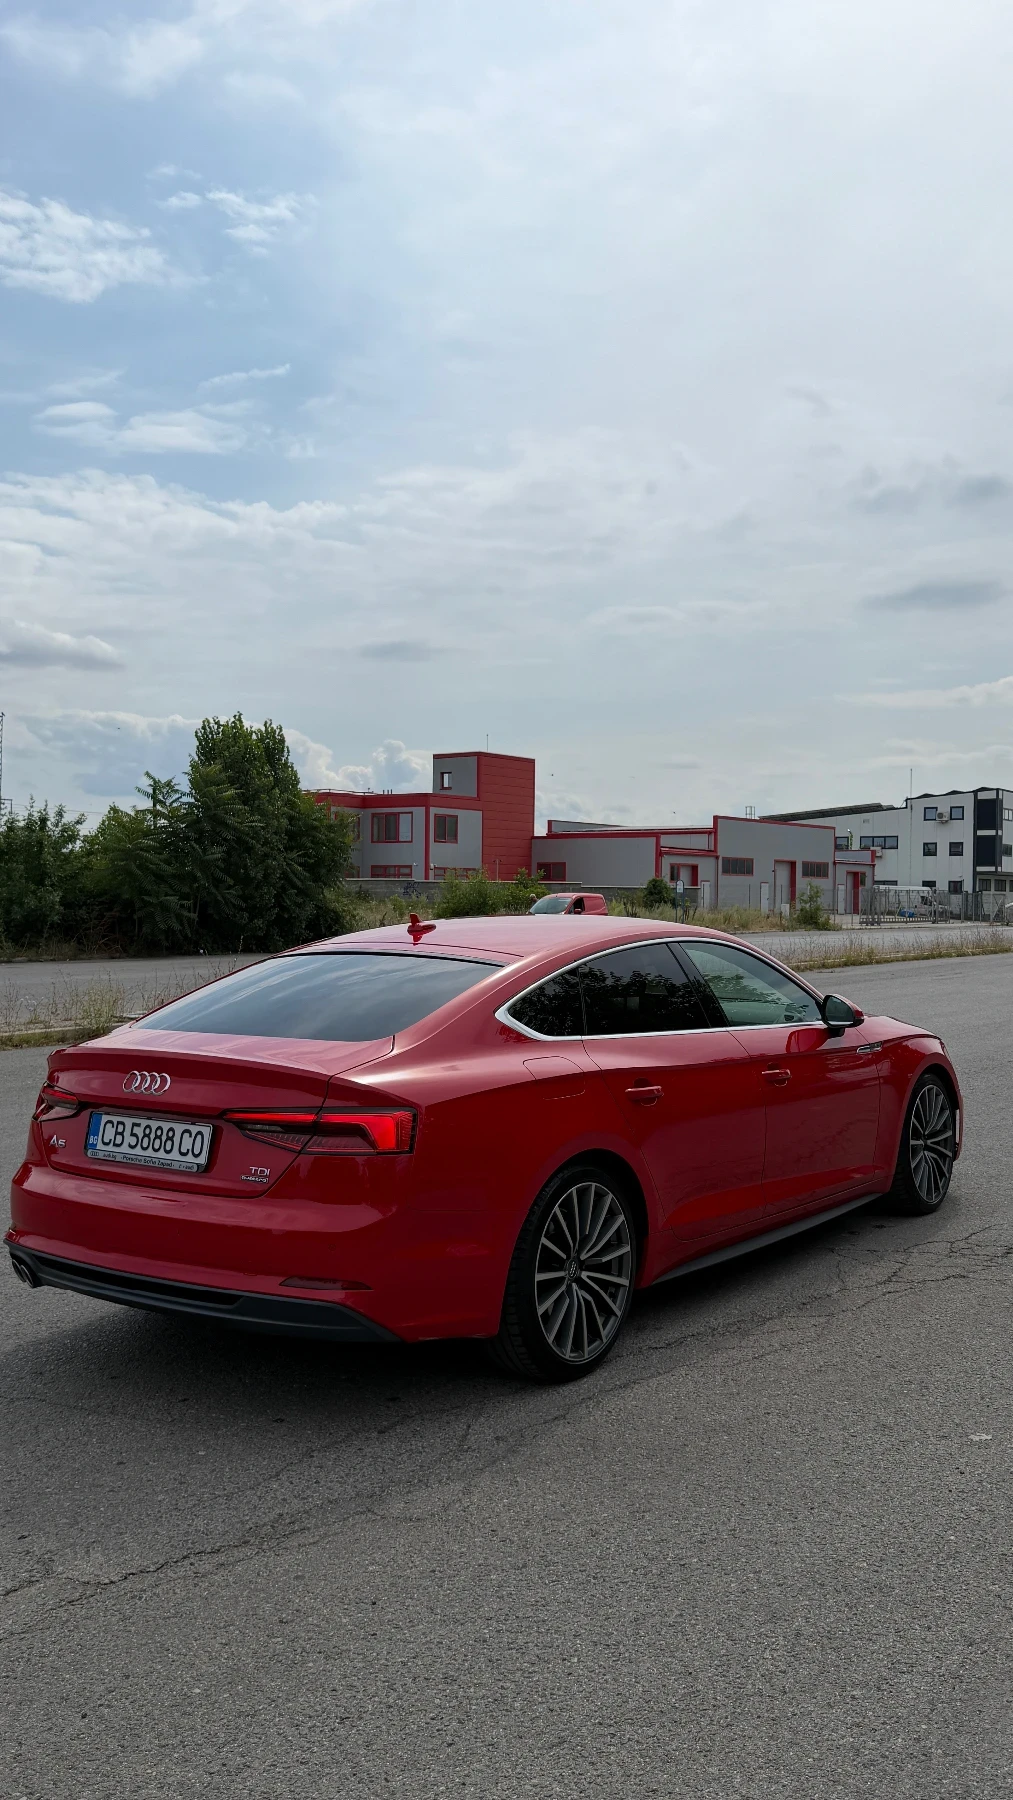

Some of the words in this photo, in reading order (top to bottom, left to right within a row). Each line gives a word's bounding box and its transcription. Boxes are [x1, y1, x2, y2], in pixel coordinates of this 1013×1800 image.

[48, 1134, 66, 1148] A5
[89, 1136, 98, 1144] BG
[101, 1120, 126, 1148] CB
[128, 1122, 176, 1154] 5888
[249, 1166, 271, 1176] TDI
